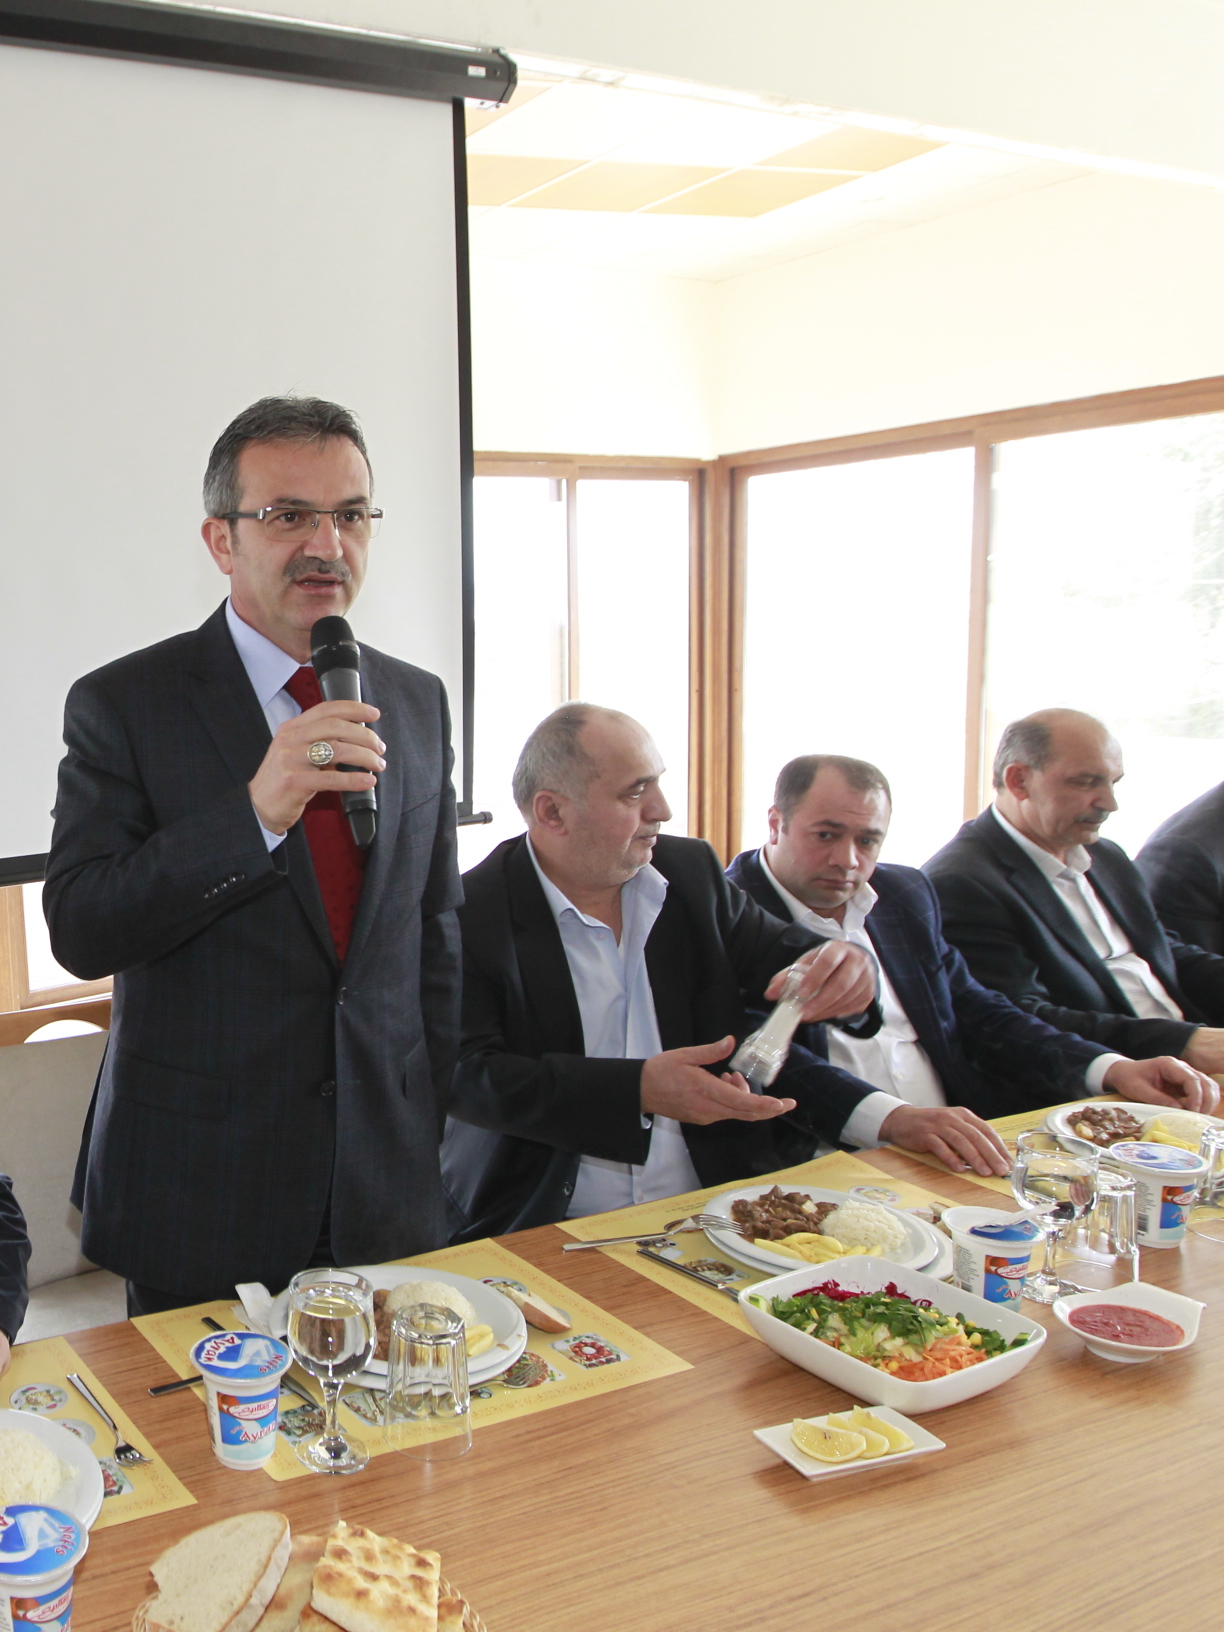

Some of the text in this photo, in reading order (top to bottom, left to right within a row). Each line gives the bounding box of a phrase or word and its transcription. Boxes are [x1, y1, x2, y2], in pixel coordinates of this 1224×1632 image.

[204, 1335, 236, 1363] Ayran
[258, 1353, 284, 1374] Nefis
[240, 1421, 277, 1442] Ayran
[54, 1524, 77, 1557] Nefis
